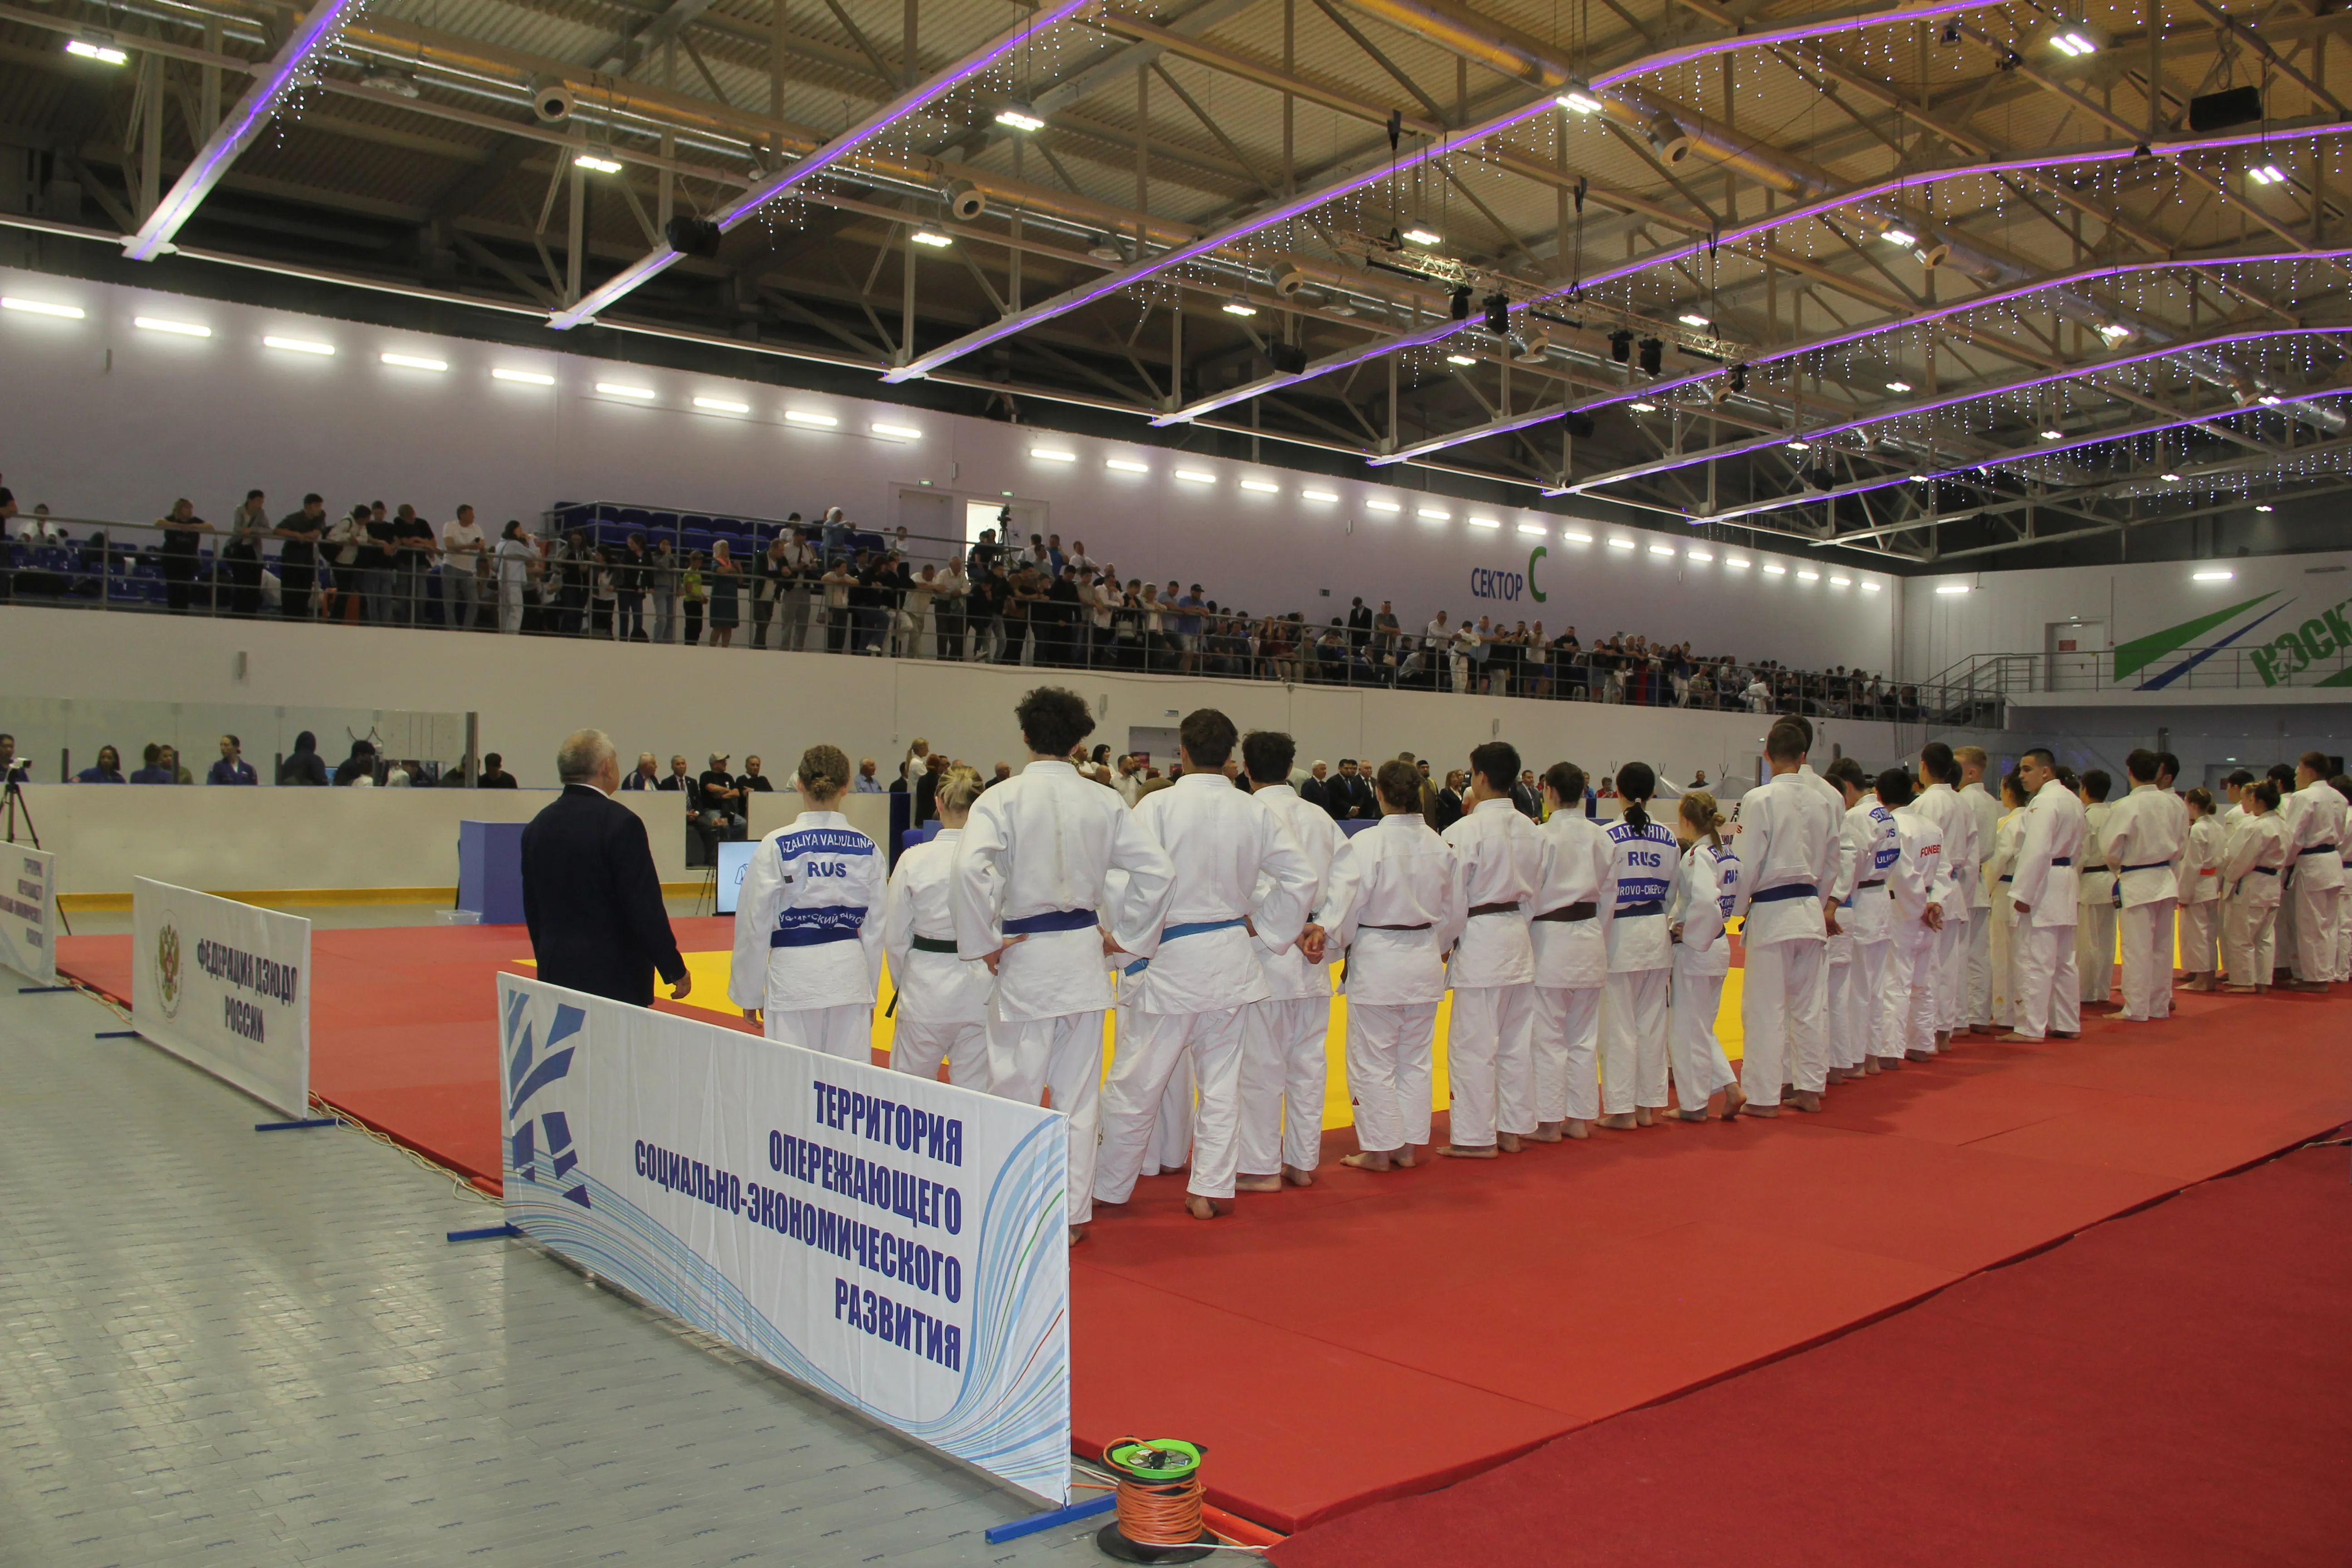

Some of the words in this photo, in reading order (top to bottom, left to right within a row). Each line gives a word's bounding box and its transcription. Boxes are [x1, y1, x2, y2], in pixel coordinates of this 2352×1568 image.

[1471, 567, 1523, 602] СЕКТОР
[782, 833, 818, 853] AZALIYA
[820, 834, 873, 848] VALIULLINA
[808, 862, 847, 877] RUS
[1628, 852, 1661, 867] RUS
[197, 938, 254, 990] ФЕДЕРАЦИЯ
[255, 956, 298, 1008] ДЗЮДО
[225, 995, 265, 1044] РОССИИ
[813, 1080, 962, 1167] ТЕРРИТОРИЯ
[769, 1130, 962, 1235] ОПЕРЕЖАЮЩЕГО
[635, 1139, 961, 1303] СОЦИАЛЬНО-ЭКОНОМИЧЕСКОГО
[835, 1277, 961, 1373] РАЗВИТИЯ
